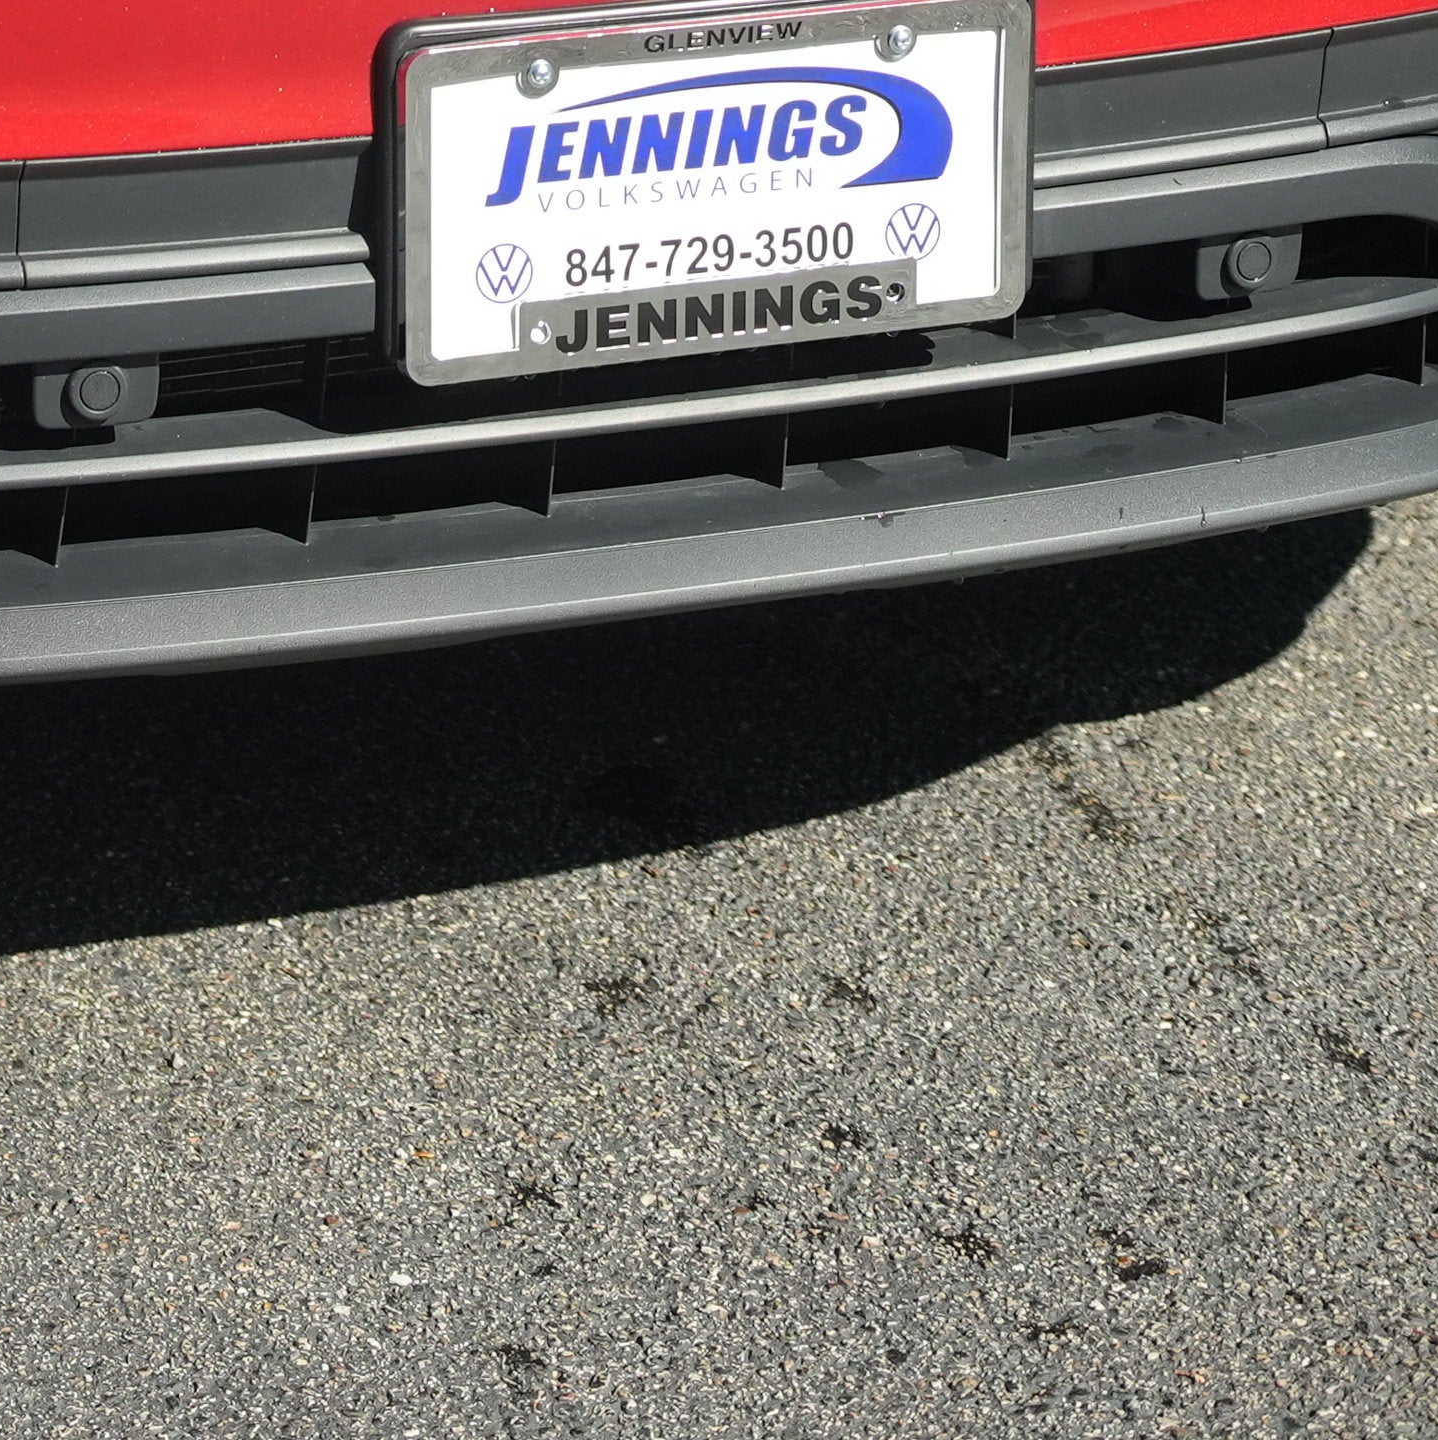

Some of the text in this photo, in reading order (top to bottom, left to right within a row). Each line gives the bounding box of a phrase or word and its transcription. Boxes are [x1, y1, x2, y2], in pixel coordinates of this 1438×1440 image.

[644, 20, 803, 53] GLENVIEW
[486, 96, 867, 206] JENNINGS
[538, 168, 813, 213] VOLKSWAGEN
[565, 222, 854, 287] 847-729-3500
[556, 276, 883, 355] JENNINGS
